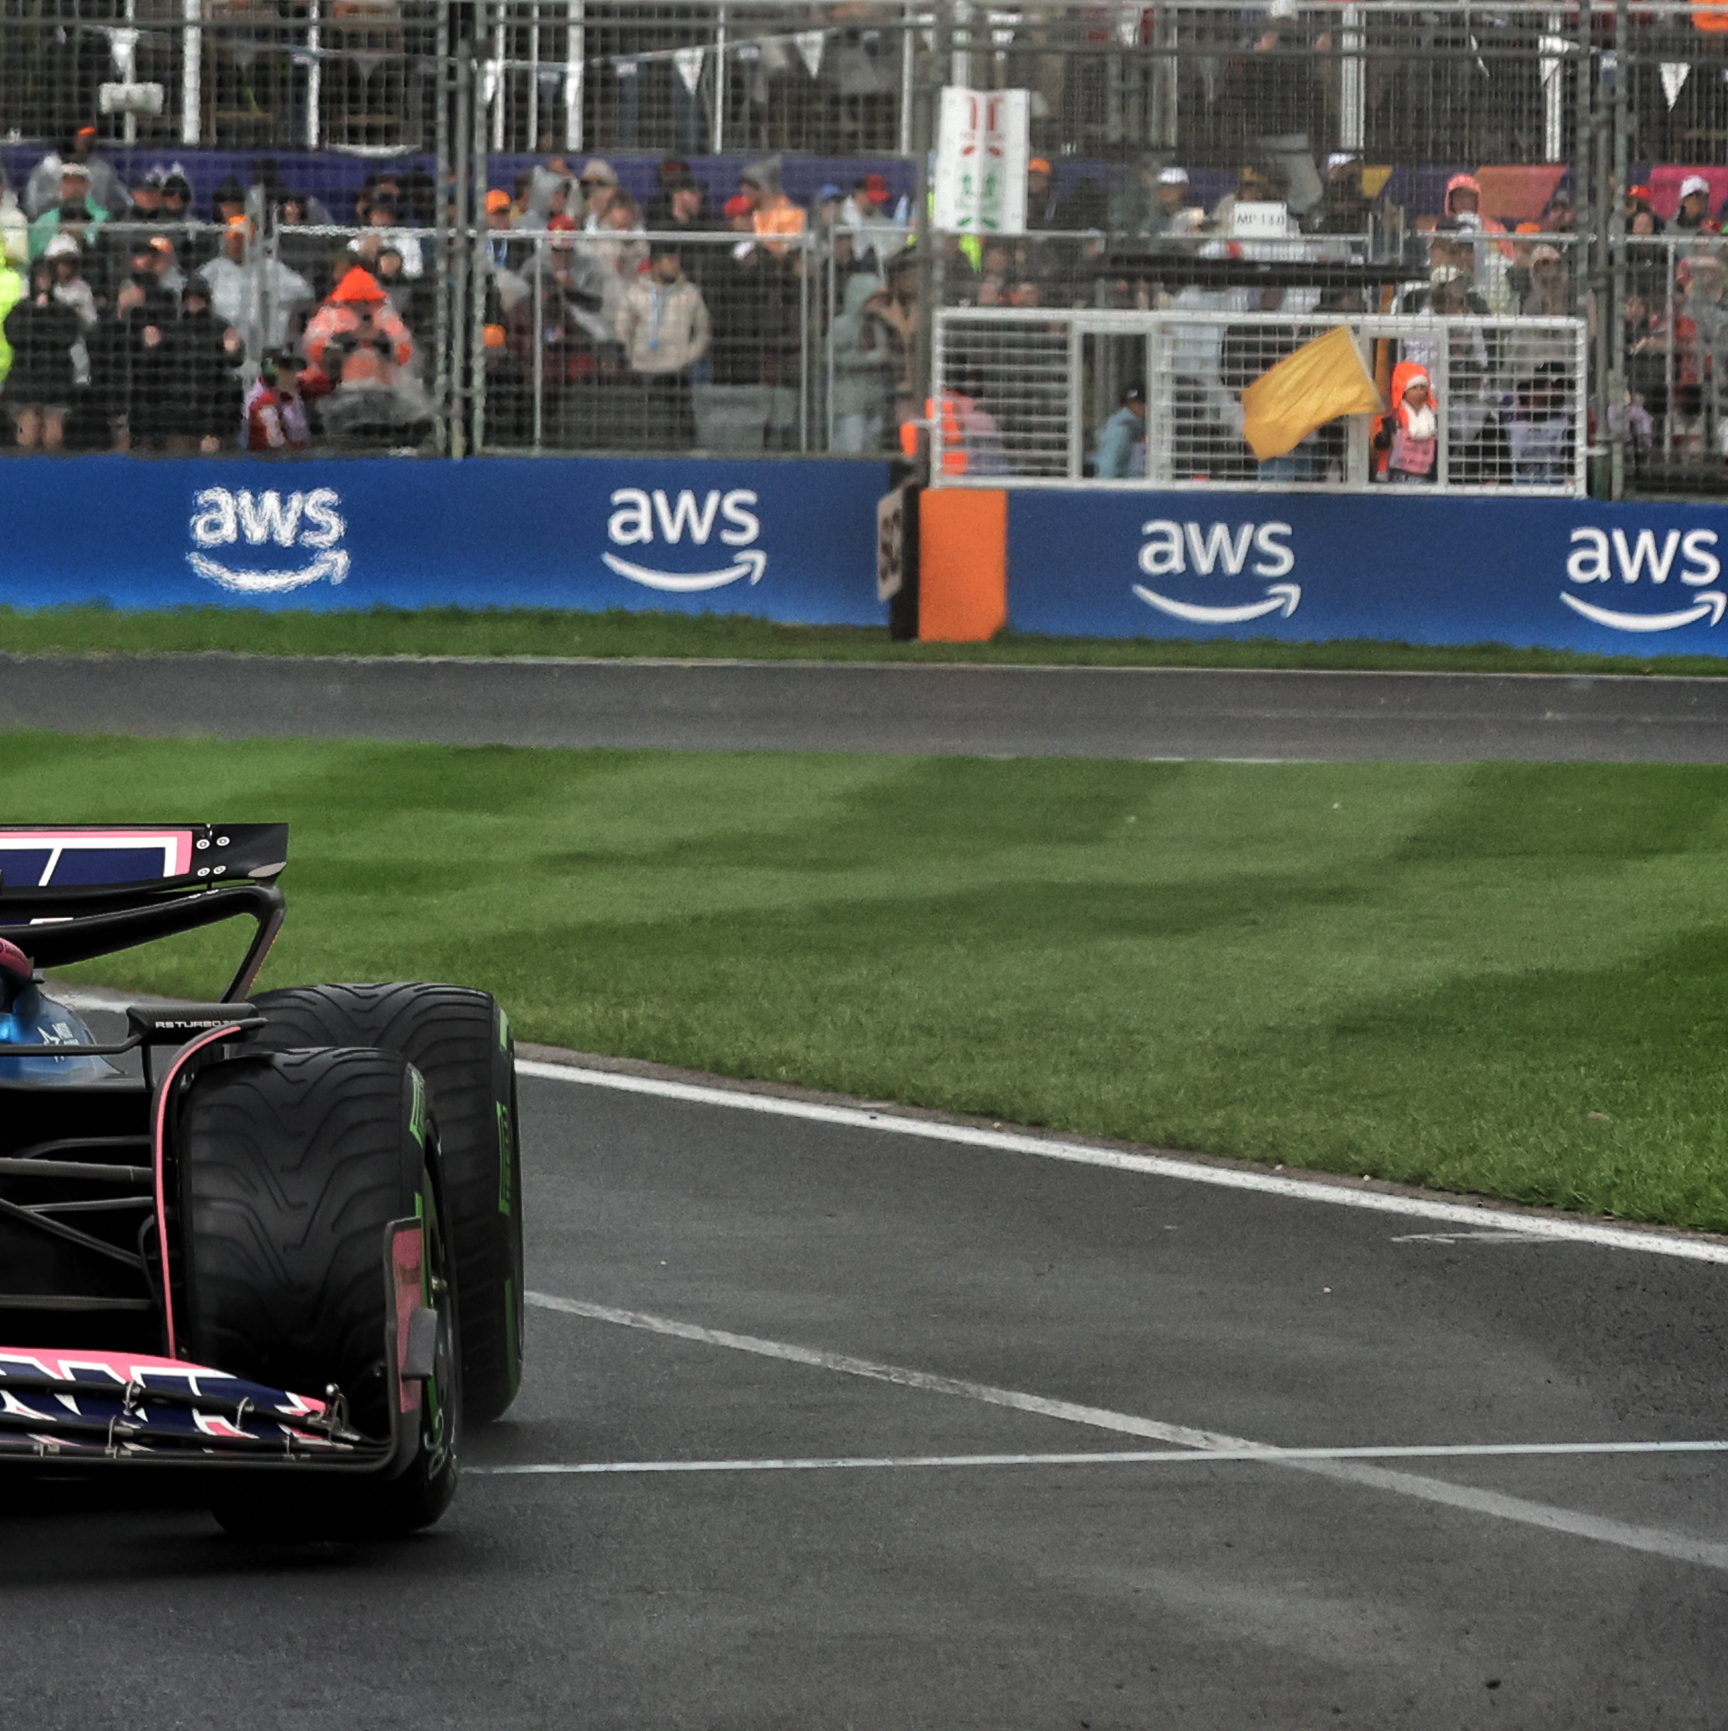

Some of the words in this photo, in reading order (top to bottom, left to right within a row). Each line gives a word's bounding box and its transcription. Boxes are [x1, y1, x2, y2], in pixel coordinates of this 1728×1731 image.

[191, 487, 345, 548] aws
[609, 489, 760, 545] aws
[1139, 521, 1295, 576] aws
[1567, 528, 1721, 585] aws
